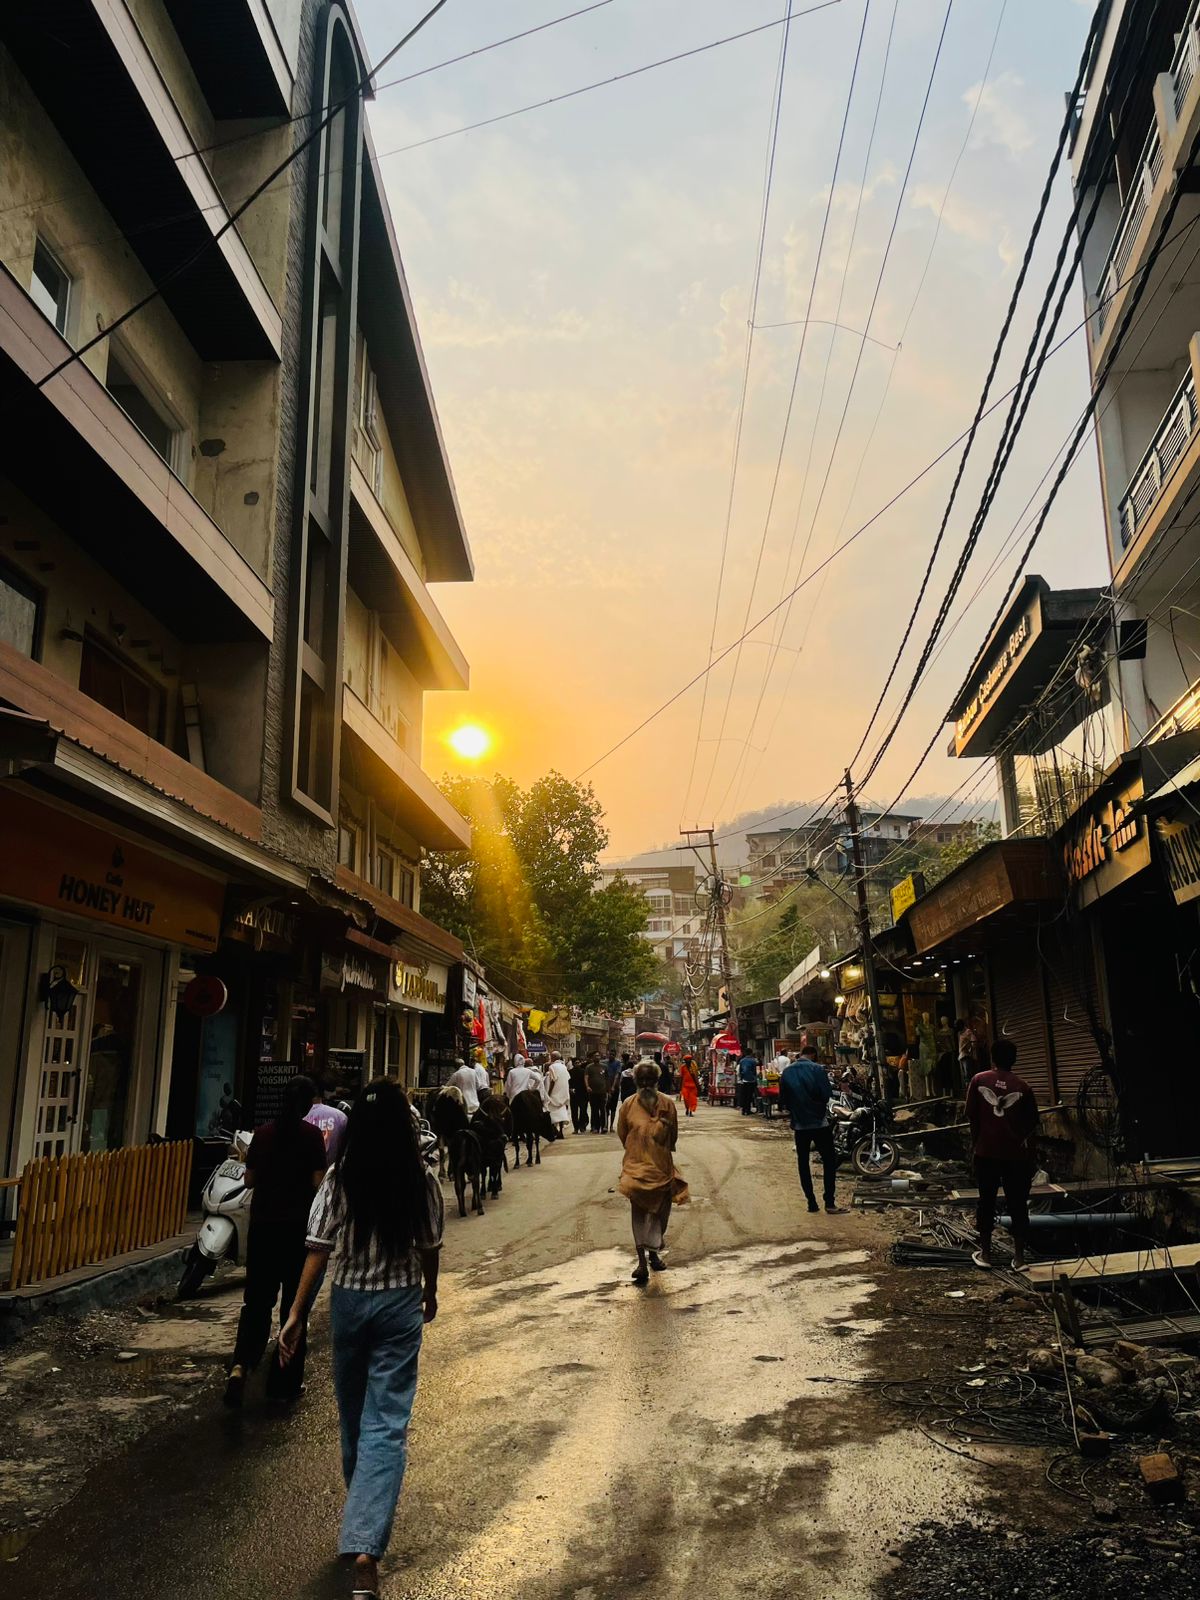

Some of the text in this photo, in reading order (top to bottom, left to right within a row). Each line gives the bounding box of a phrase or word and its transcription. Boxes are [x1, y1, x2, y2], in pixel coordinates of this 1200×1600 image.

[1008, 615, 1028, 656] Best
[1107, 799, 1138, 852] Inn
[58, 873, 155, 925] HONEY HUT
[257, 1064, 299, 1075] SANSKRITI
[257, 1075, 291, 1085] YOGSHA
